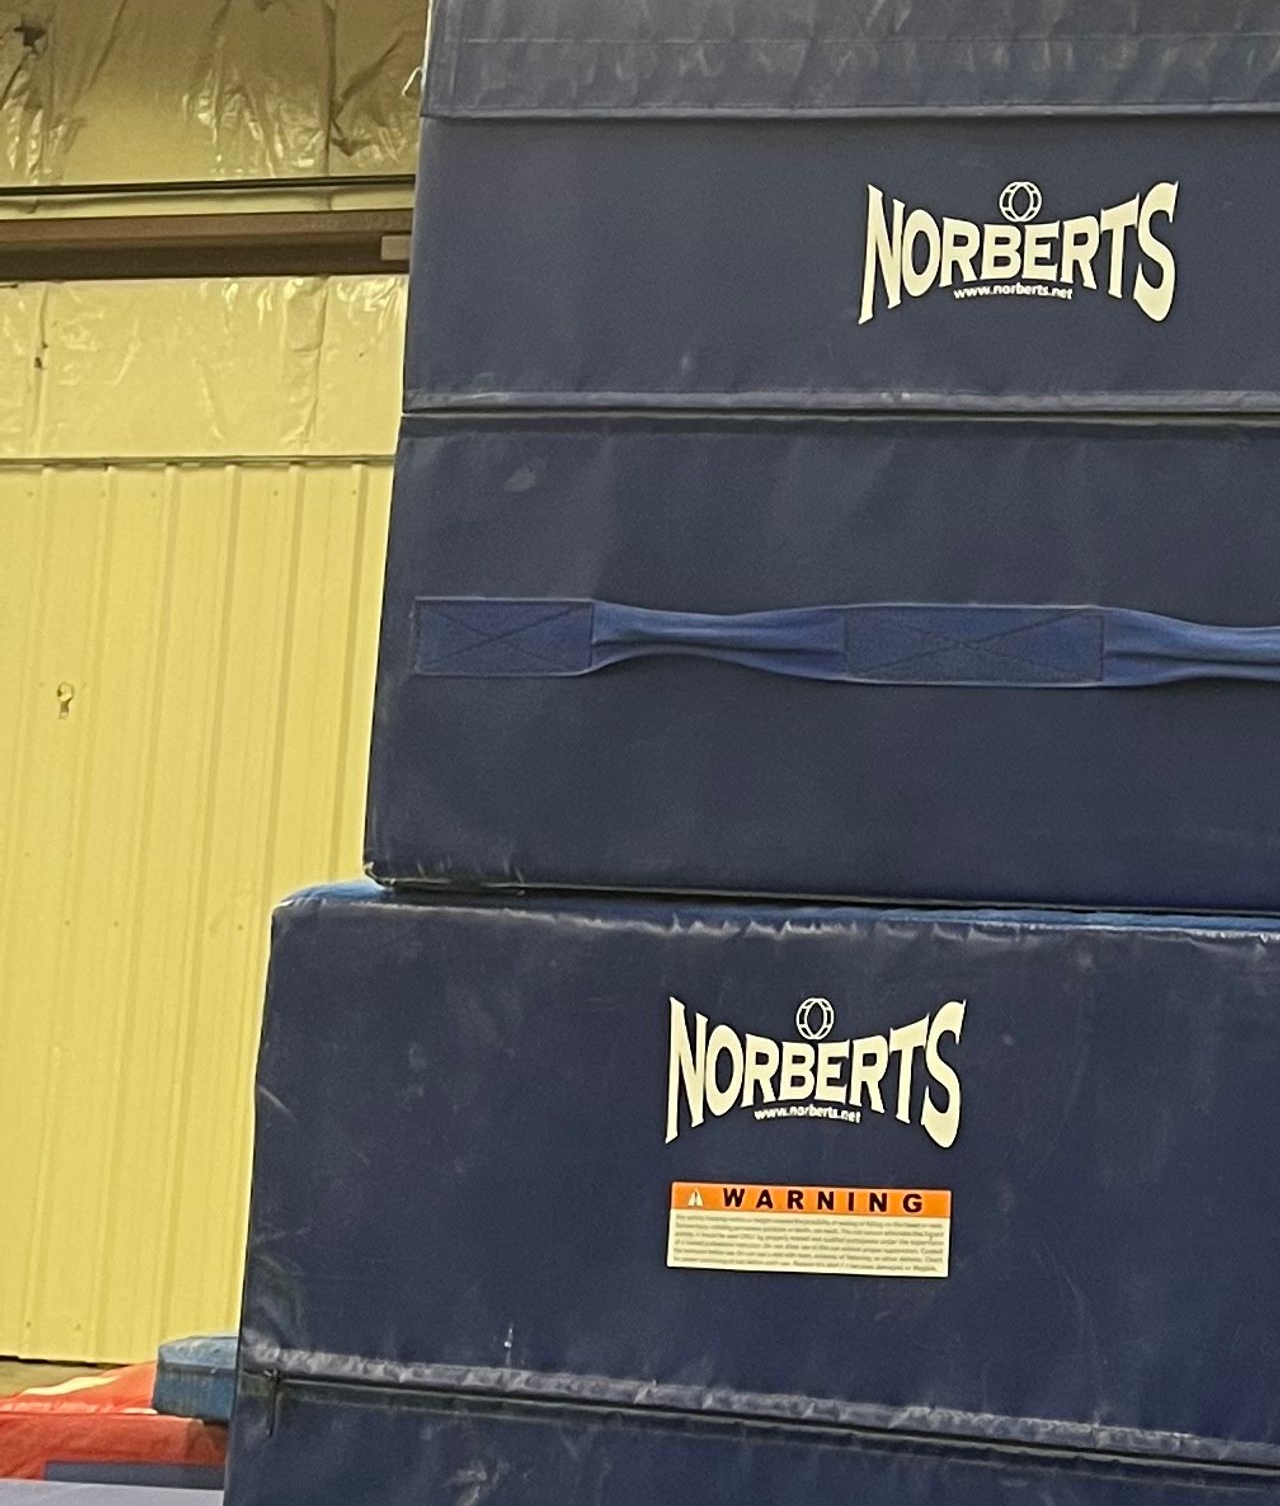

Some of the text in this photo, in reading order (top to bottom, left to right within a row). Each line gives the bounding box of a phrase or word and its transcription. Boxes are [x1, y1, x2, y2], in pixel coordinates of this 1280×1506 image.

[858, 181, 1179, 325] NORBERTS
[953, 282, 1073, 300] www.norberts.net
[665, 997, 966, 1148] NORBERTS
[754, 1104, 861, 1123] www.norberts.net
[723, 1187, 923, 1213] WARNING
